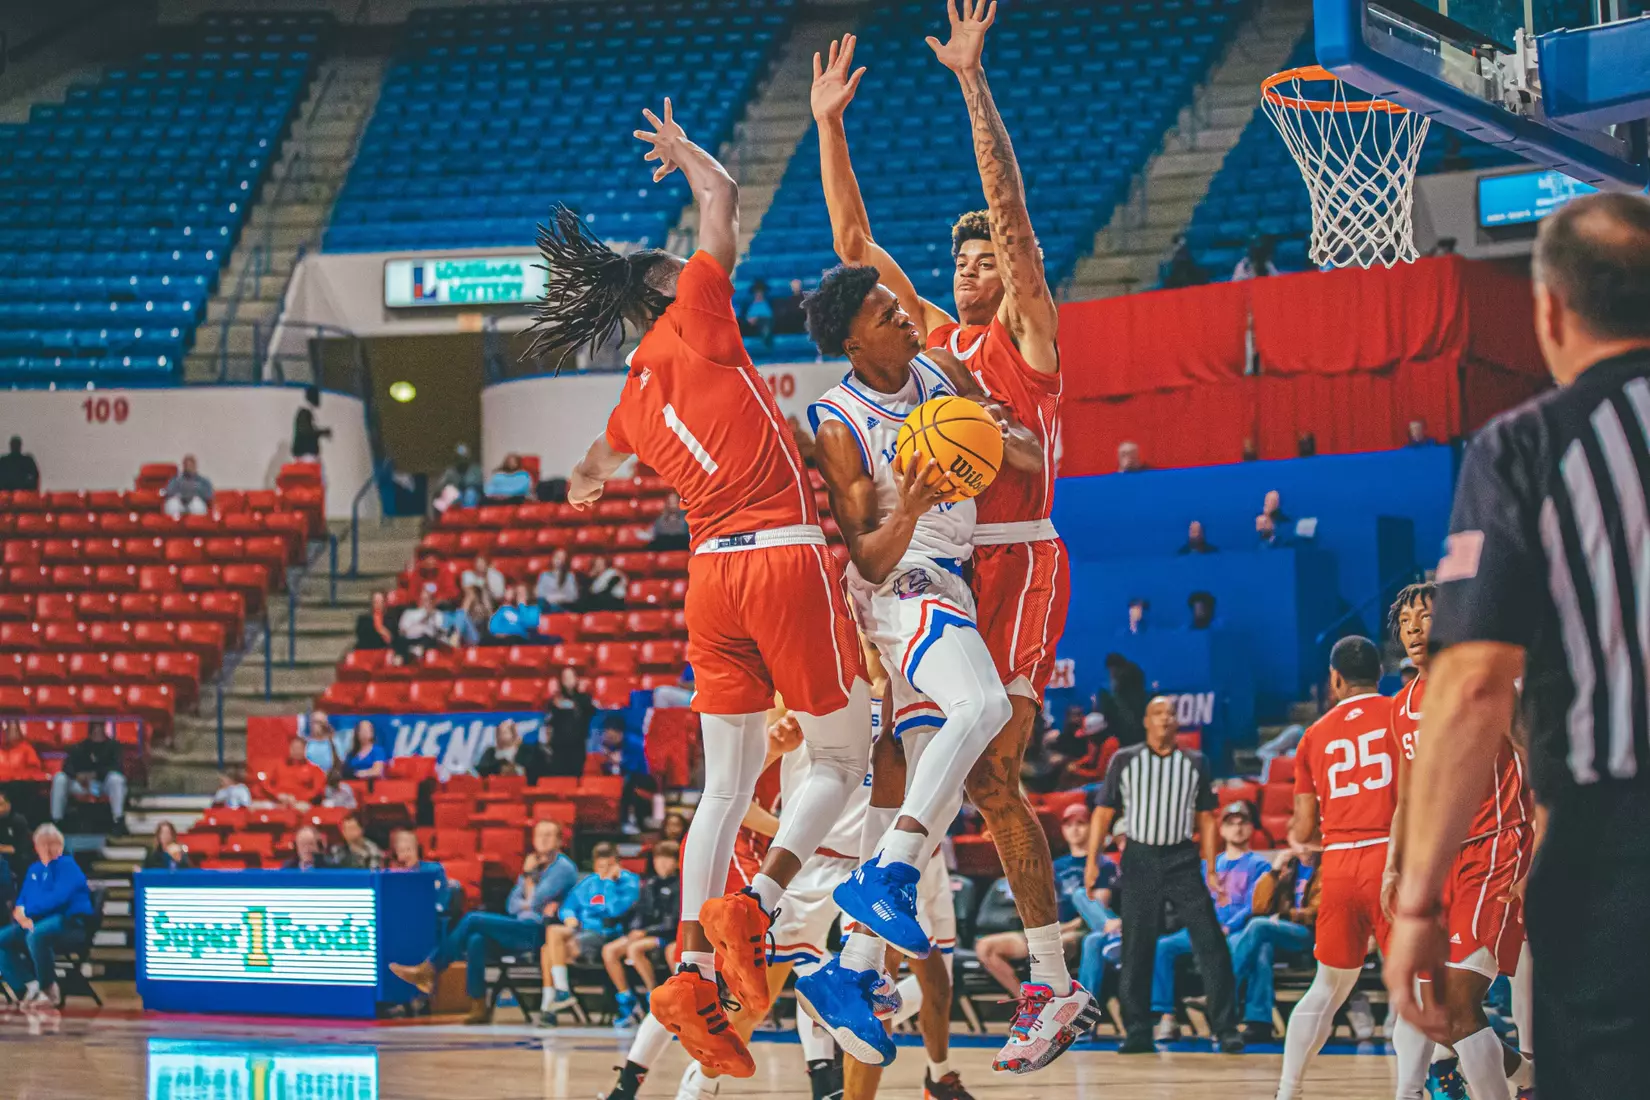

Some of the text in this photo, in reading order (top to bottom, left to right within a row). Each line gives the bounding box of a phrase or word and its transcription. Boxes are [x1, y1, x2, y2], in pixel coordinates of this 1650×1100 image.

[81, 397, 129, 425] 109
[662, 402, 719, 476] 1
[1325, 728, 1393, 800] 25
[152, 906, 376, 973] Super 1 Foods
